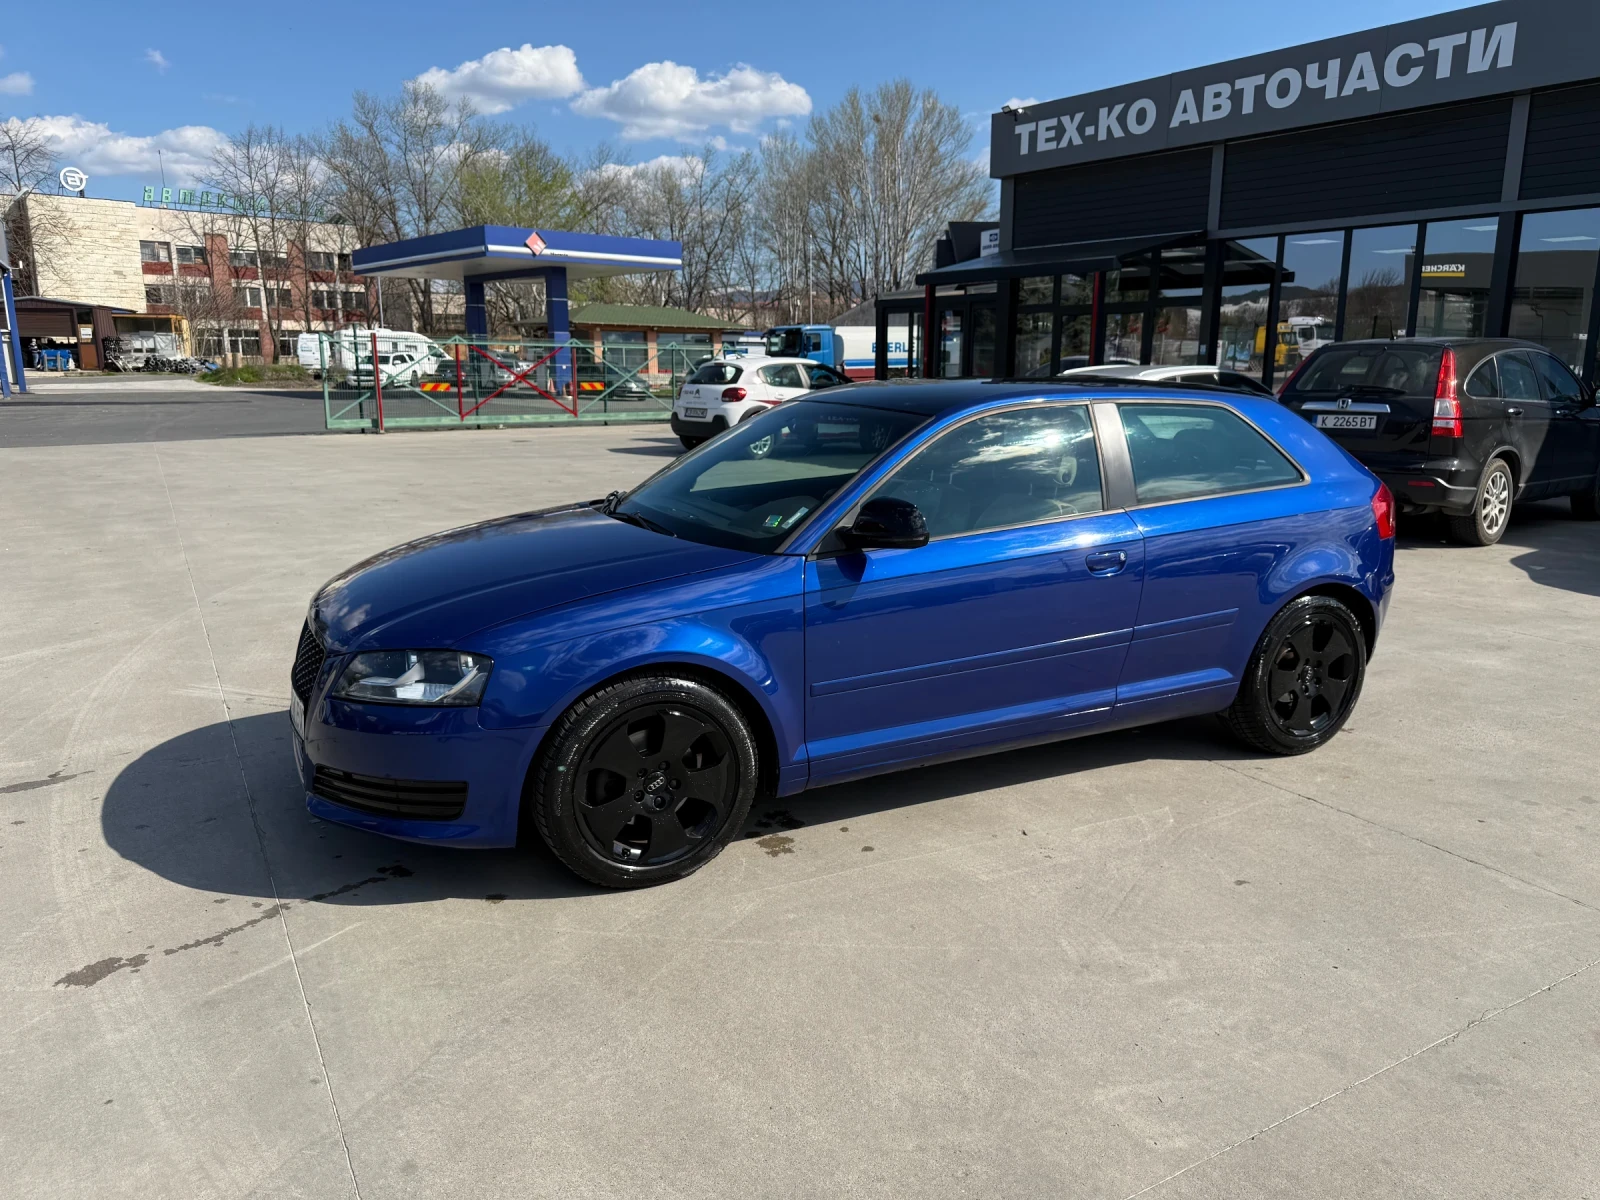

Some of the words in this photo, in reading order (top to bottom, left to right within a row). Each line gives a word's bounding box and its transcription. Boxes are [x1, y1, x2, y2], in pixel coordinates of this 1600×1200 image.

[1014, 98, 1157, 155] ТЕХ-КО
[1168, 21, 1518, 128] АВТОЧАСТИ
[871, 341, 916, 353] EERLE
[1321, 416, 1328, 426] K
